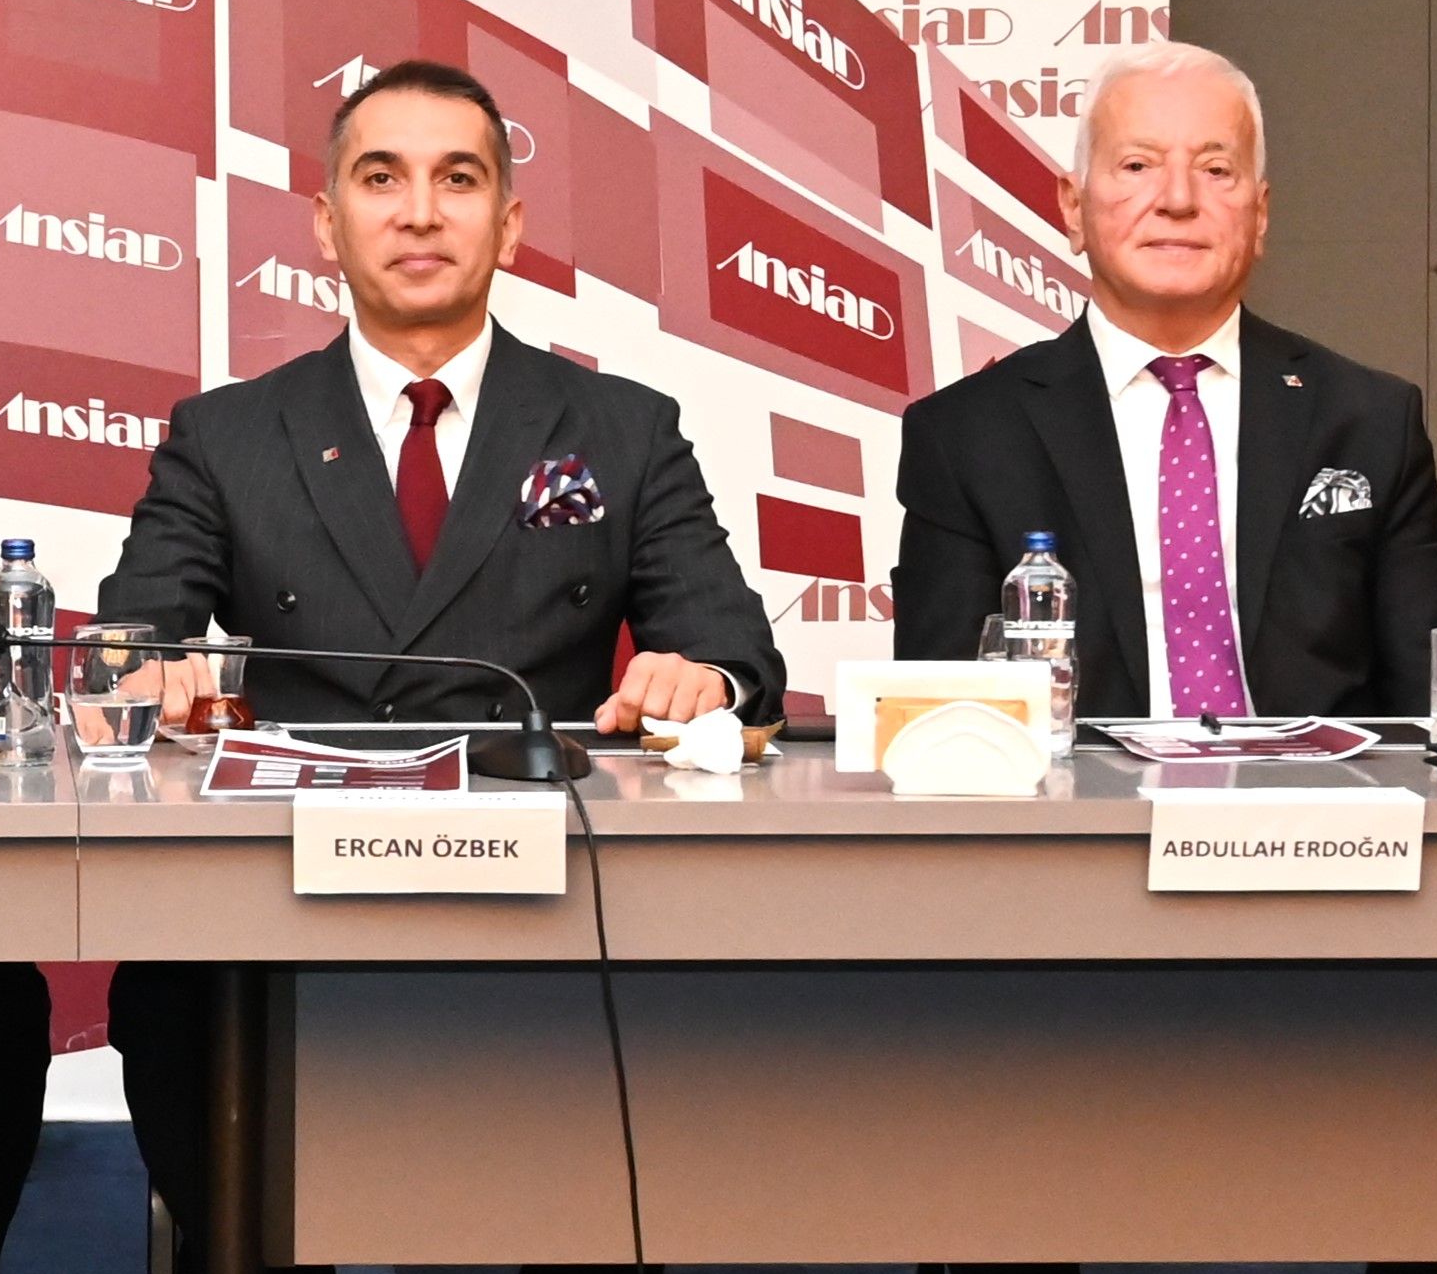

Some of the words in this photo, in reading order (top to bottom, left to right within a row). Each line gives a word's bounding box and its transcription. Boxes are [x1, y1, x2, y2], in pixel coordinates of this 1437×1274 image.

[334, 838, 423, 858] ERCAN
[432, 834, 519, 858] ÖZBEK
[1163, 840, 1285, 858] ABDULLAH
[1294, 836, 1408, 858] ERDOĞAN
